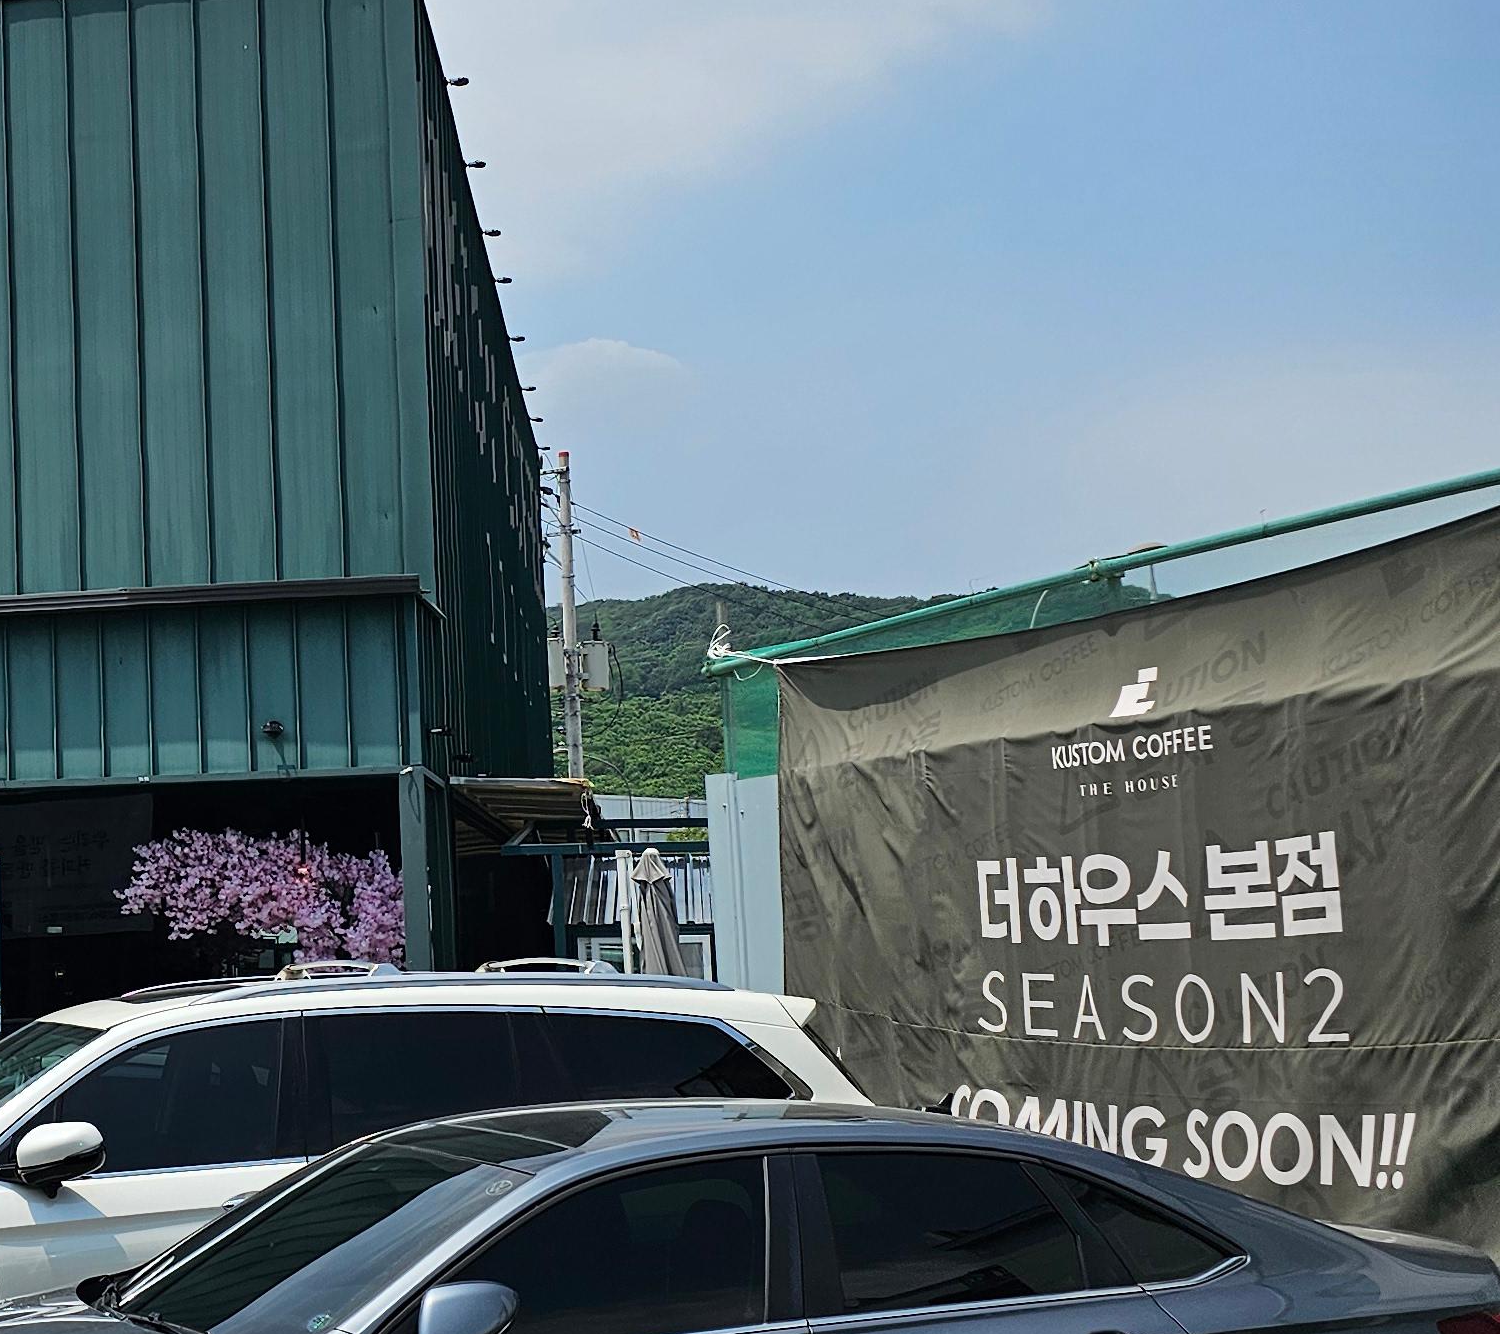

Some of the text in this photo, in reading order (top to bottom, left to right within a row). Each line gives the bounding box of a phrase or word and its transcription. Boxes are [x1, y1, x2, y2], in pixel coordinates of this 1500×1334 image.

[1050, 737, 1125, 770] KUSTOM
[1132, 724, 1213, 760] COFFEE
[1079, 773, 1180, 797] THE HOUSE
[977, 851, 1191, 947] 더하우스
[1203, 831, 1344, 941] 본점
[1183, 1108, 1416, 1191] SOON!!
